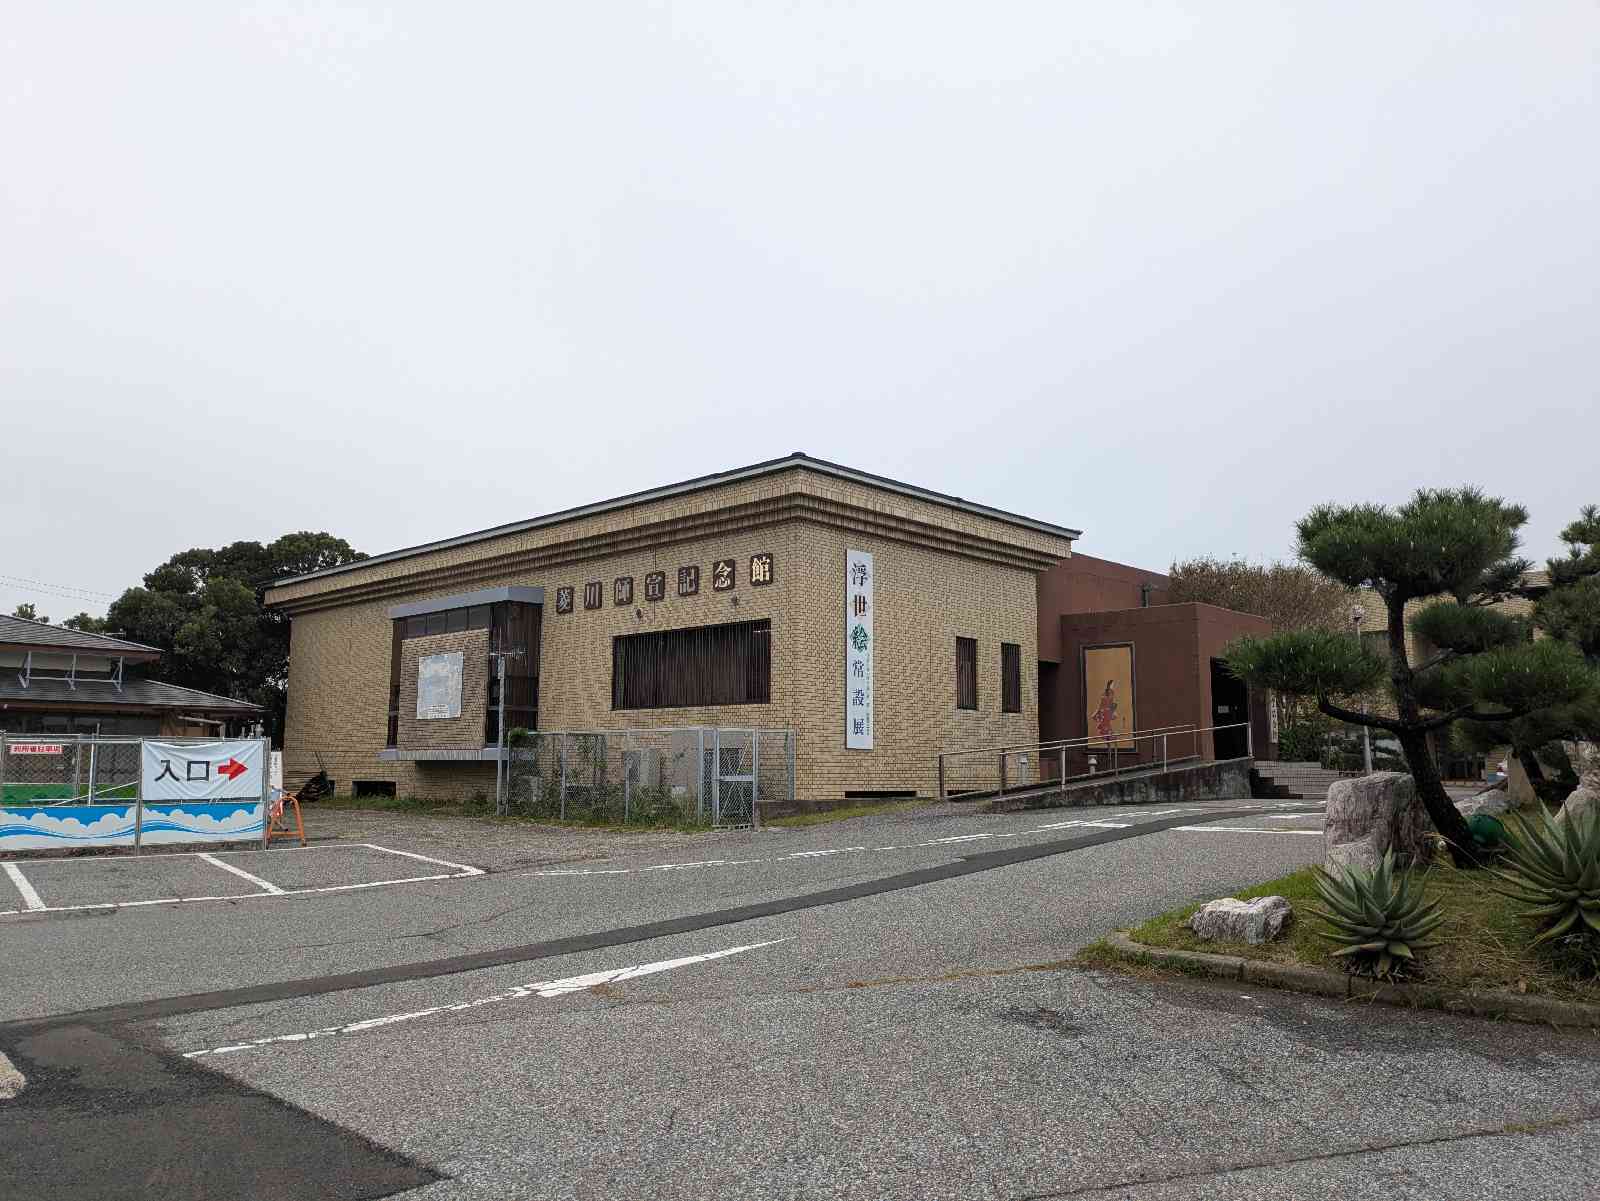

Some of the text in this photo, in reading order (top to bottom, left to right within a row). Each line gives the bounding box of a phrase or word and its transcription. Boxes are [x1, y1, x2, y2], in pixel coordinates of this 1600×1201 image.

[557, 556, 770, 611] 菱川師宣記念館
[851, 562, 869, 736] 浮世絵常設展
[154, 759, 210, 782] 入口
